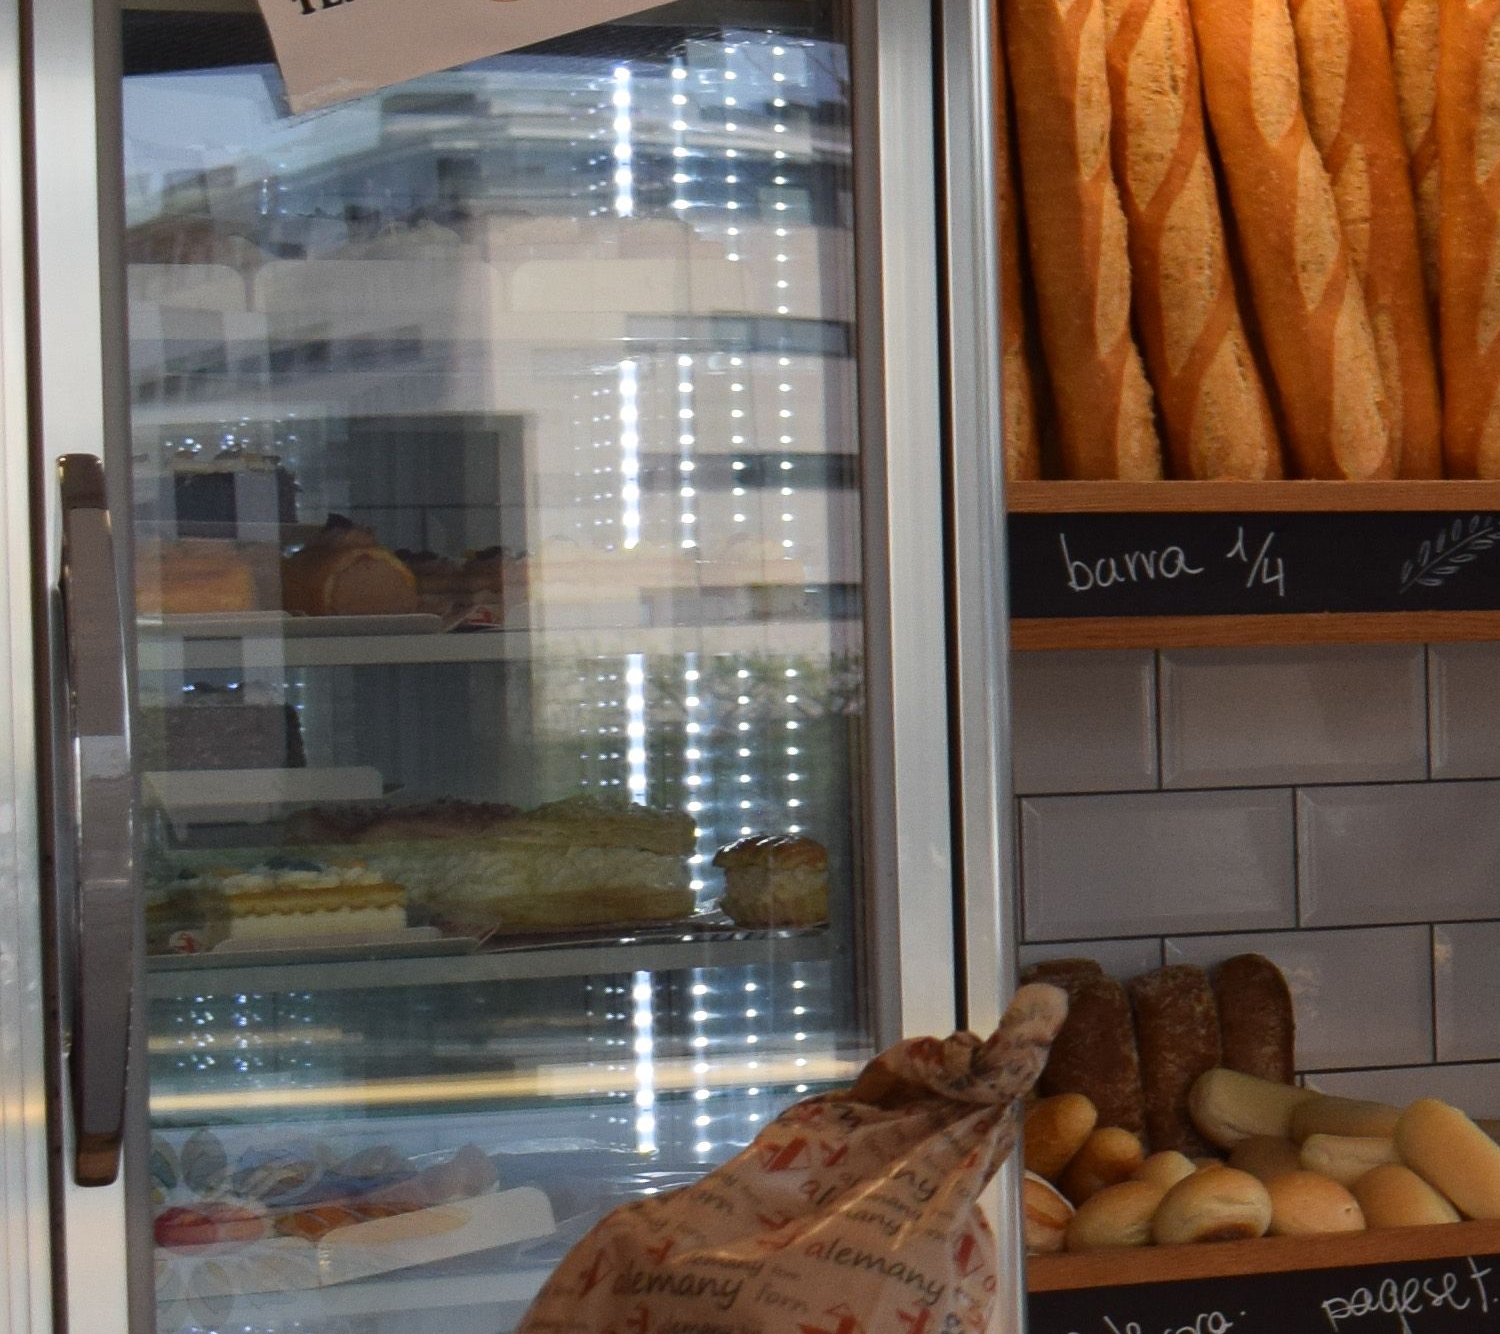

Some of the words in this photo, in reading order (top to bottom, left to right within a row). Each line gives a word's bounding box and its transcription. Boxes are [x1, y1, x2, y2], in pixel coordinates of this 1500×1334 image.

[1057, 531, 1204, 593] barra
[1224, 526, 1289, 598] 1/4
[804, 1235, 946, 1307] alemany
